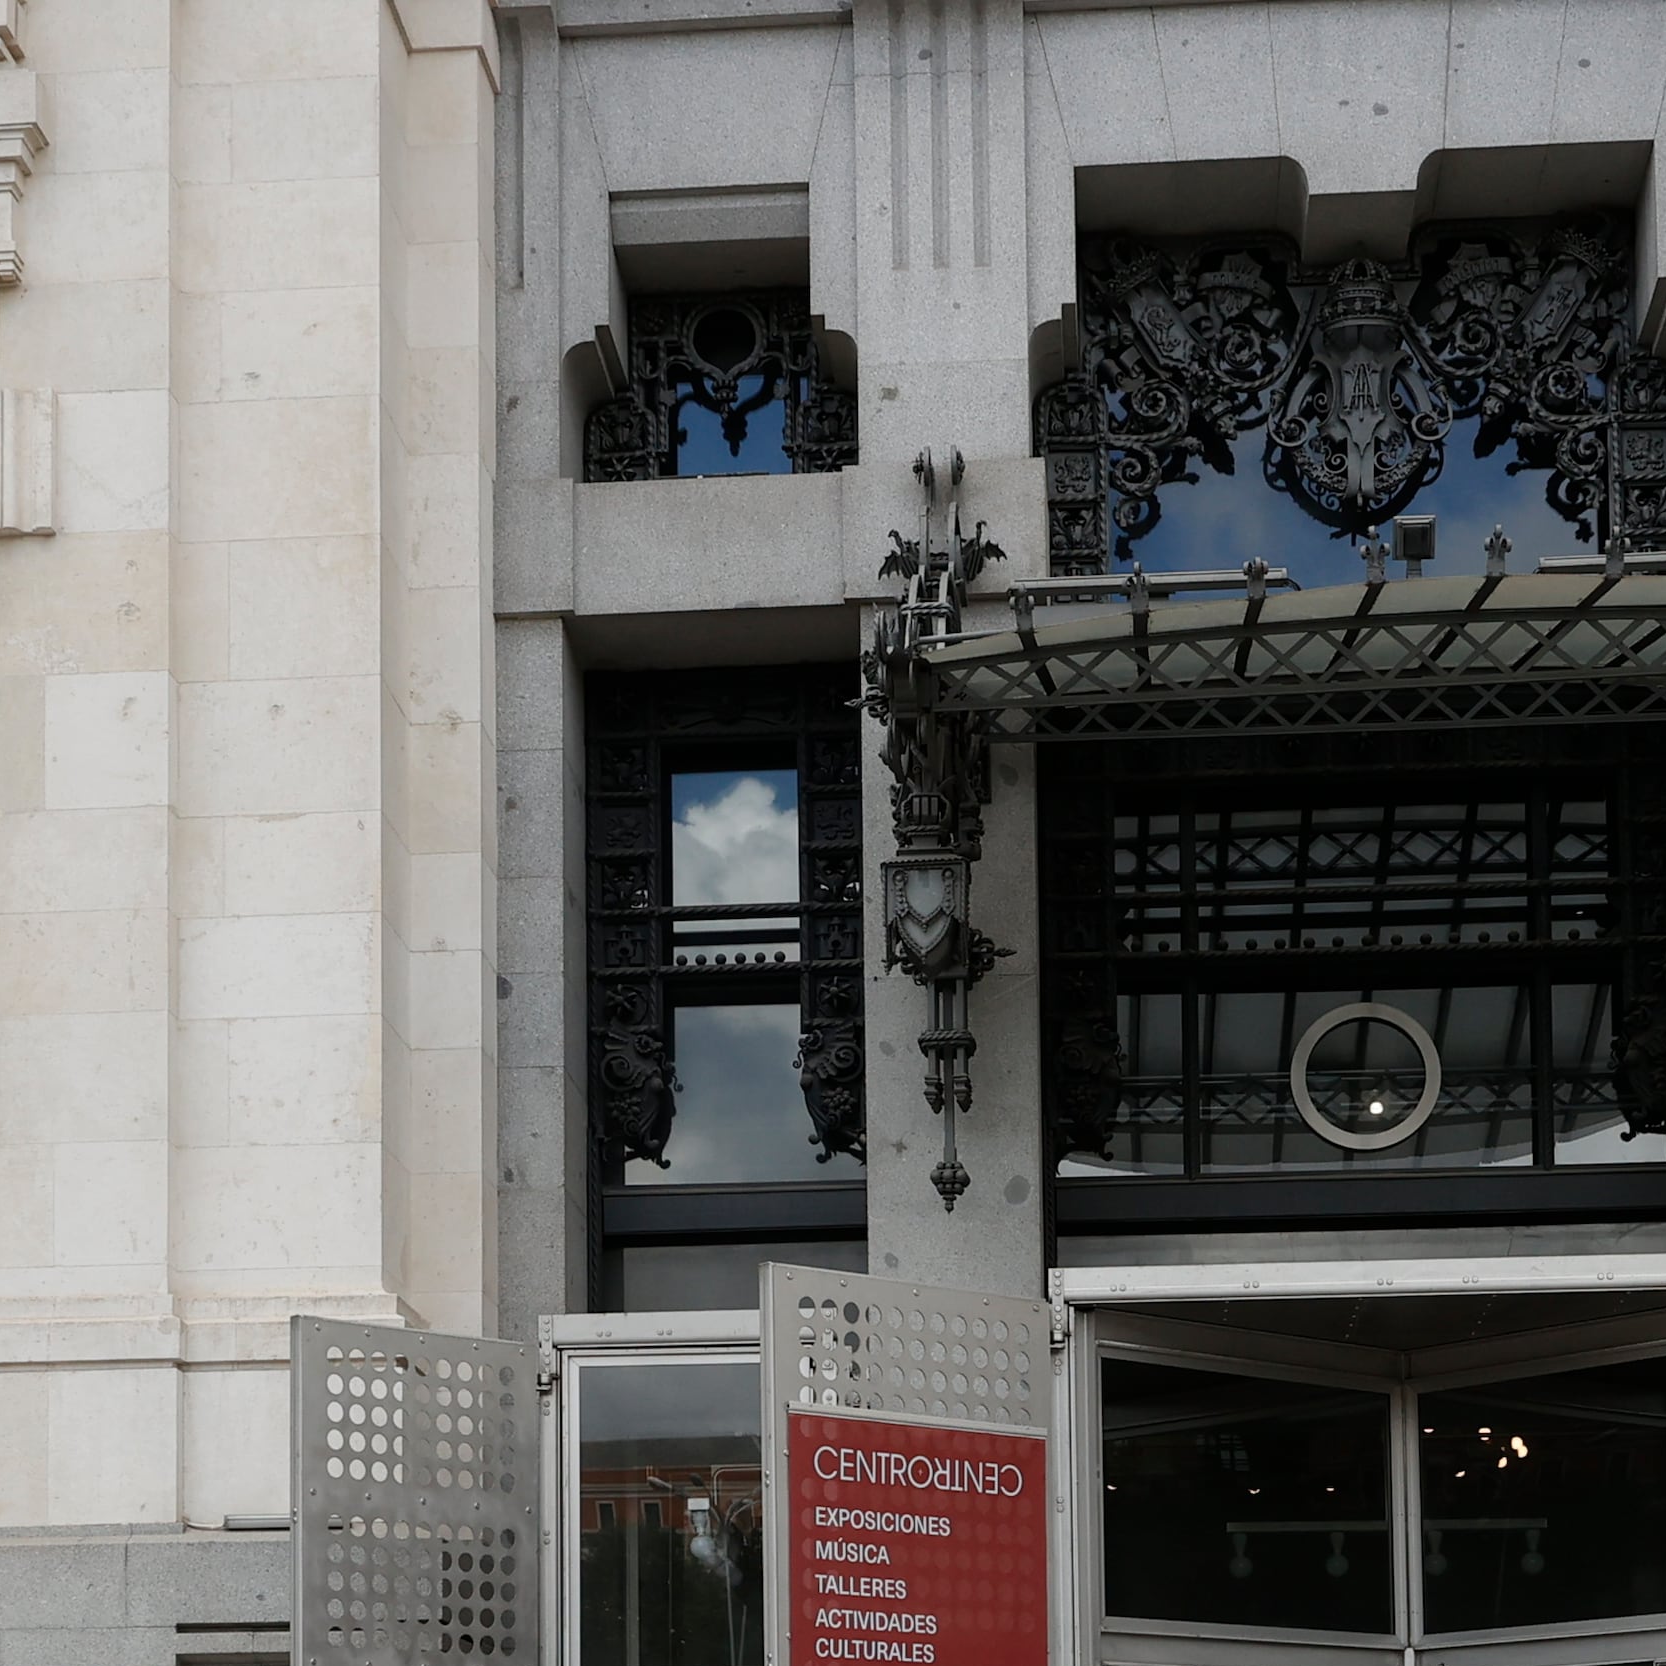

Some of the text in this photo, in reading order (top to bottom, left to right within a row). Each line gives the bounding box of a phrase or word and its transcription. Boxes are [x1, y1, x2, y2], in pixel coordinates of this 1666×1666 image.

[814, 1506, 951, 1537] EXPOSICIONES
[815, 1537, 890, 1565] MÚSICA
[815, 1574, 907, 1600] TALLERES
[815, 1608, 937, 1634] ACTIVIDADES
[815, 1638, 935, 1663] CULTURALES
